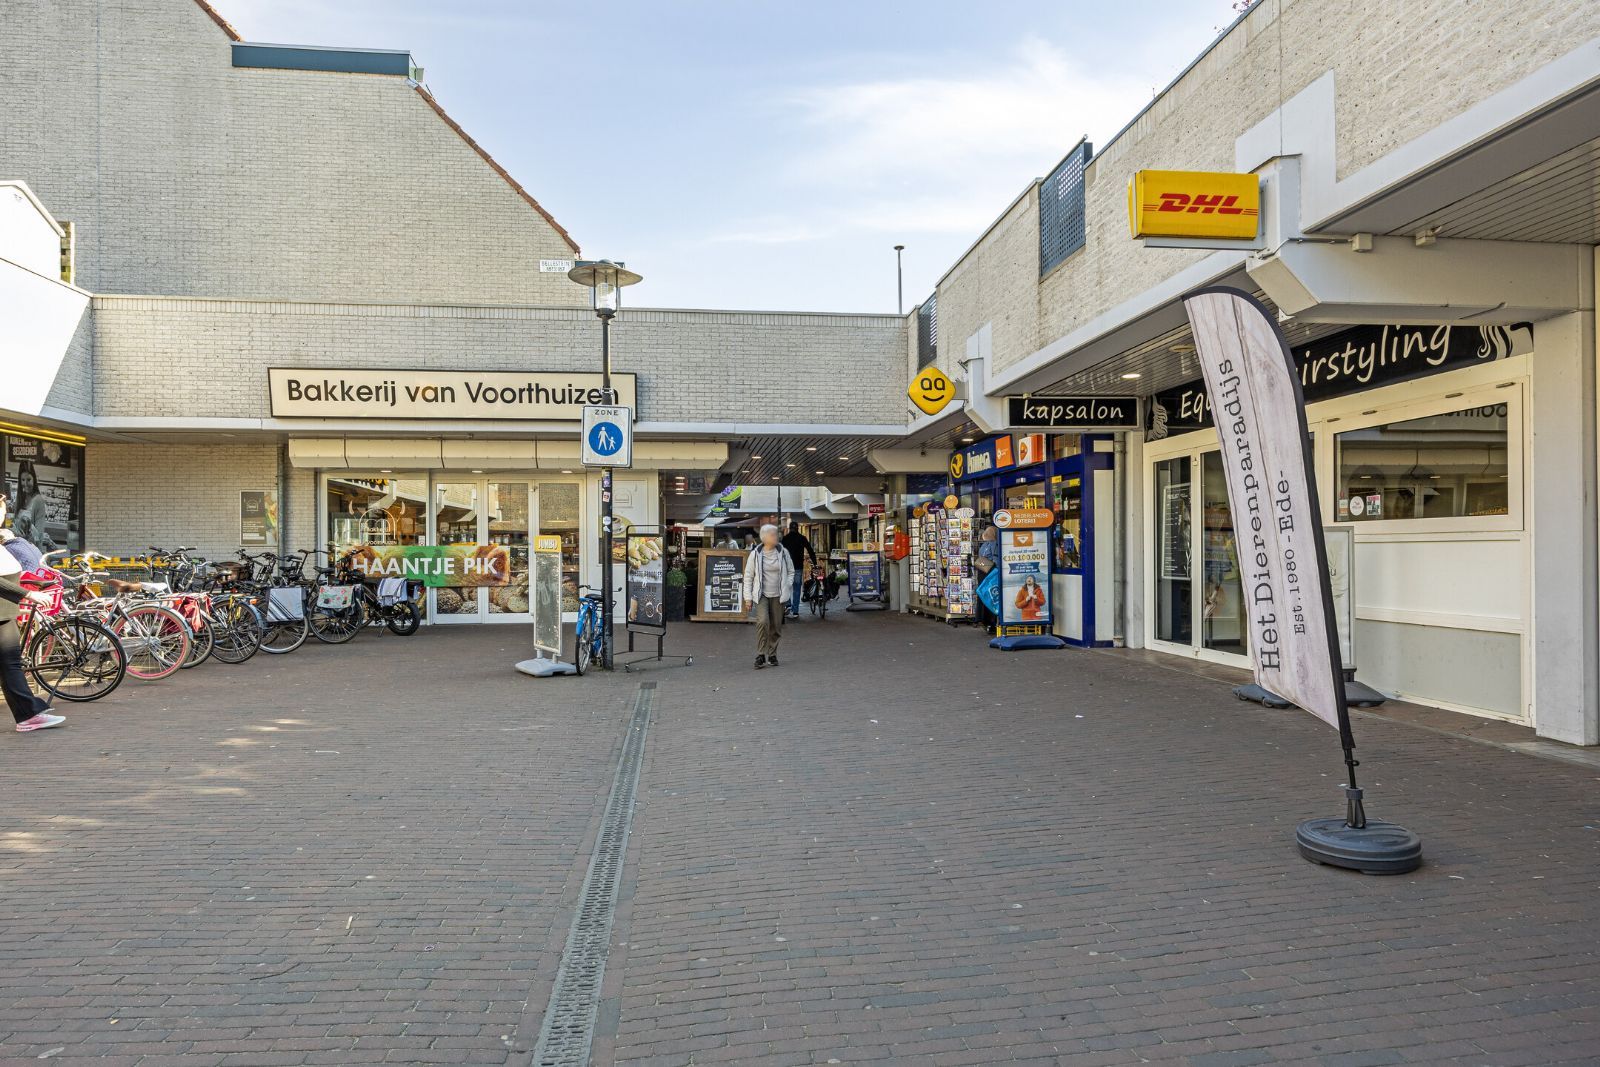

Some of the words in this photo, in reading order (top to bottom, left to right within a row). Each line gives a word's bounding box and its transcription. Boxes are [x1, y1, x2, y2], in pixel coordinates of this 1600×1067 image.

[1158, 193, 1243, 214] DHL
[1296, 324, 1451, 386] irstyling
[287, 379, 396, 407] Bakkerij
[404, 386, 455, 403] van
[464, 382, 619, 404] Voorthuizen
[1023, 399, 1124, 426] kapsalon
[1219, 359, 1274, 606] Dierenparadijs
[352, 557, 455, 575] HAANTJE
[463, 557, 498, 574] PIK
[1257, 613, 1280, 672] Het
